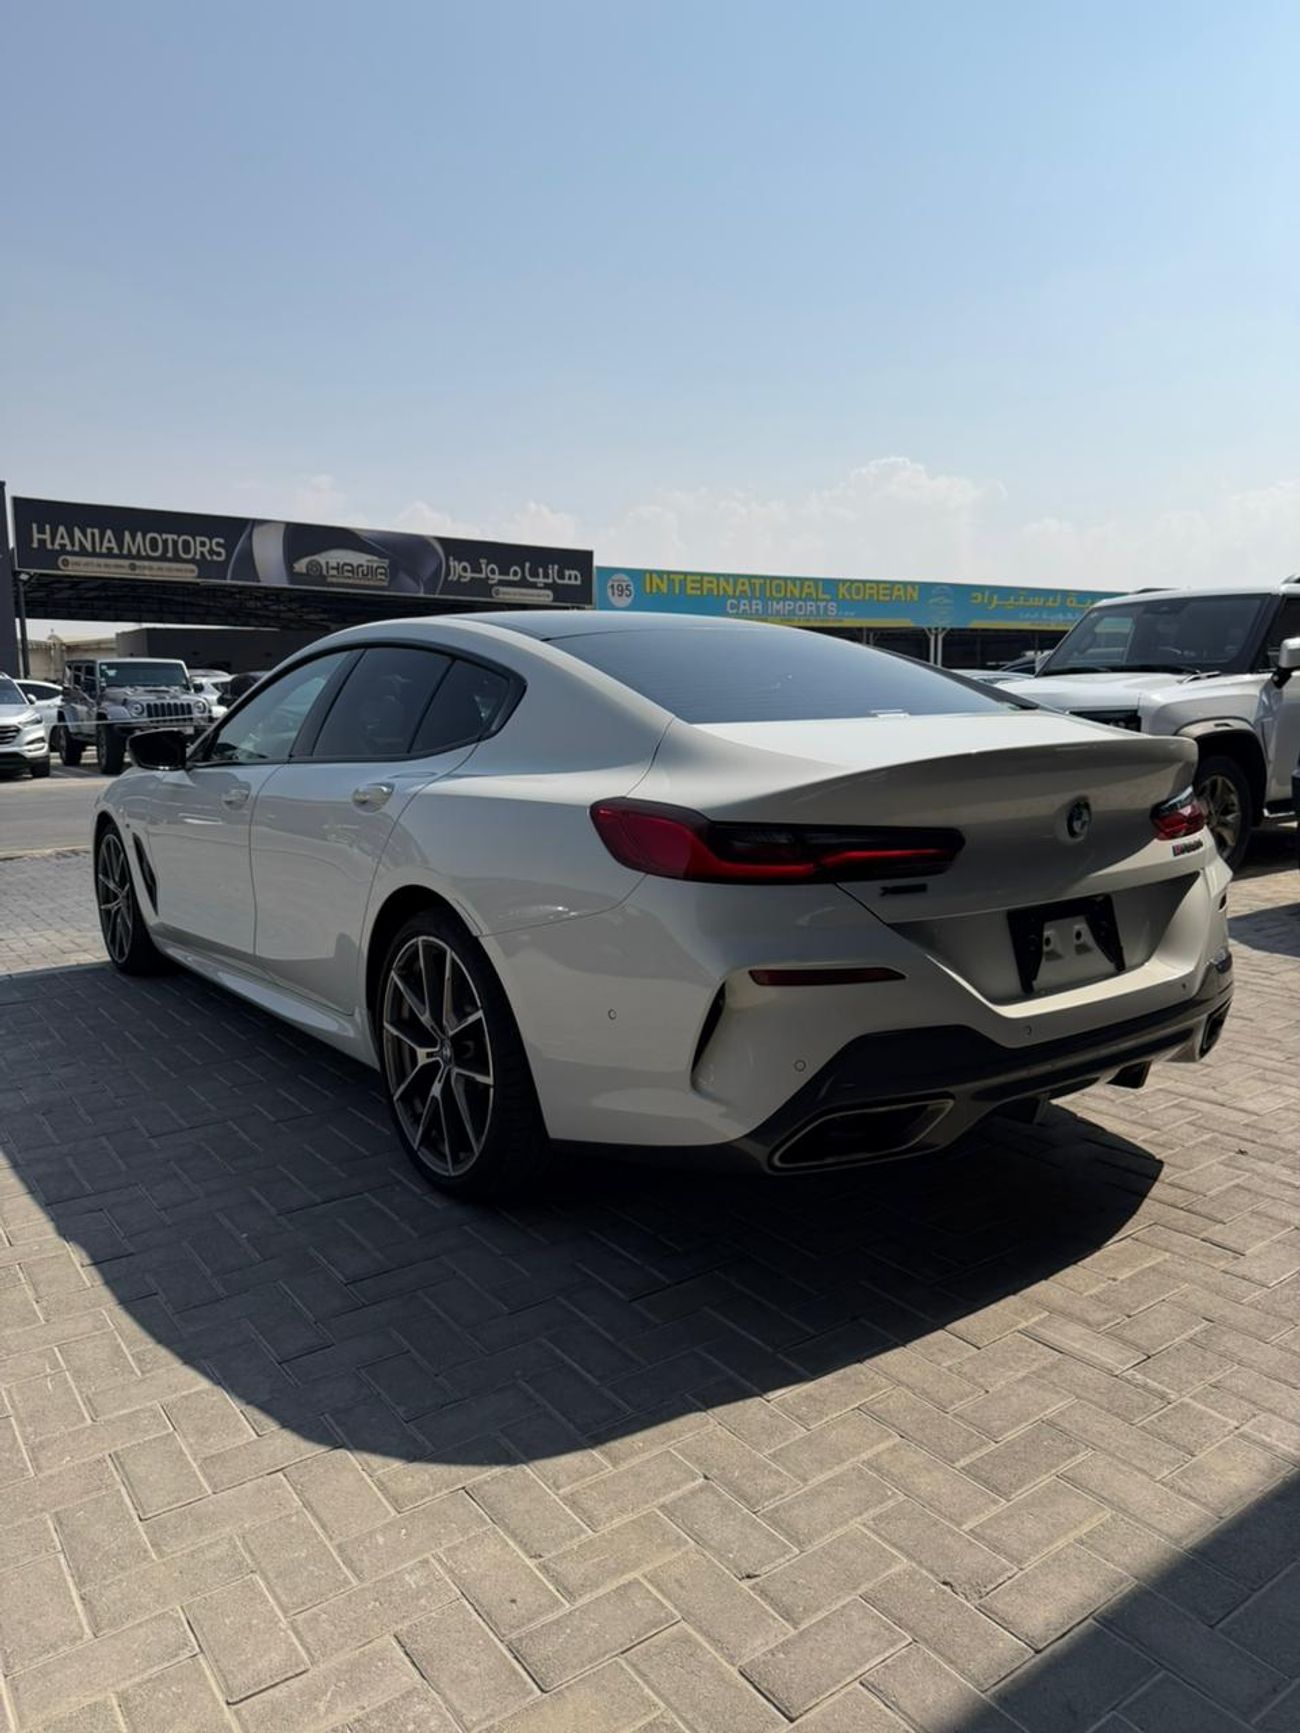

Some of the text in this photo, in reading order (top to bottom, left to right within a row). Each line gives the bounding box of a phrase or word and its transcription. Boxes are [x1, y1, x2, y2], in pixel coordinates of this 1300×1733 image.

[31, 523, 226, 562] HANIA MOTORS
[326, 561, 388, 580] HANIA
[525, 562, 581, 586] هانيا
[610, 584, 632, 598] 195
[645, 572, 919, 603] INTERNATIONAL KOREAN
[726, 599, 837, 616] CAR IMPORTS
